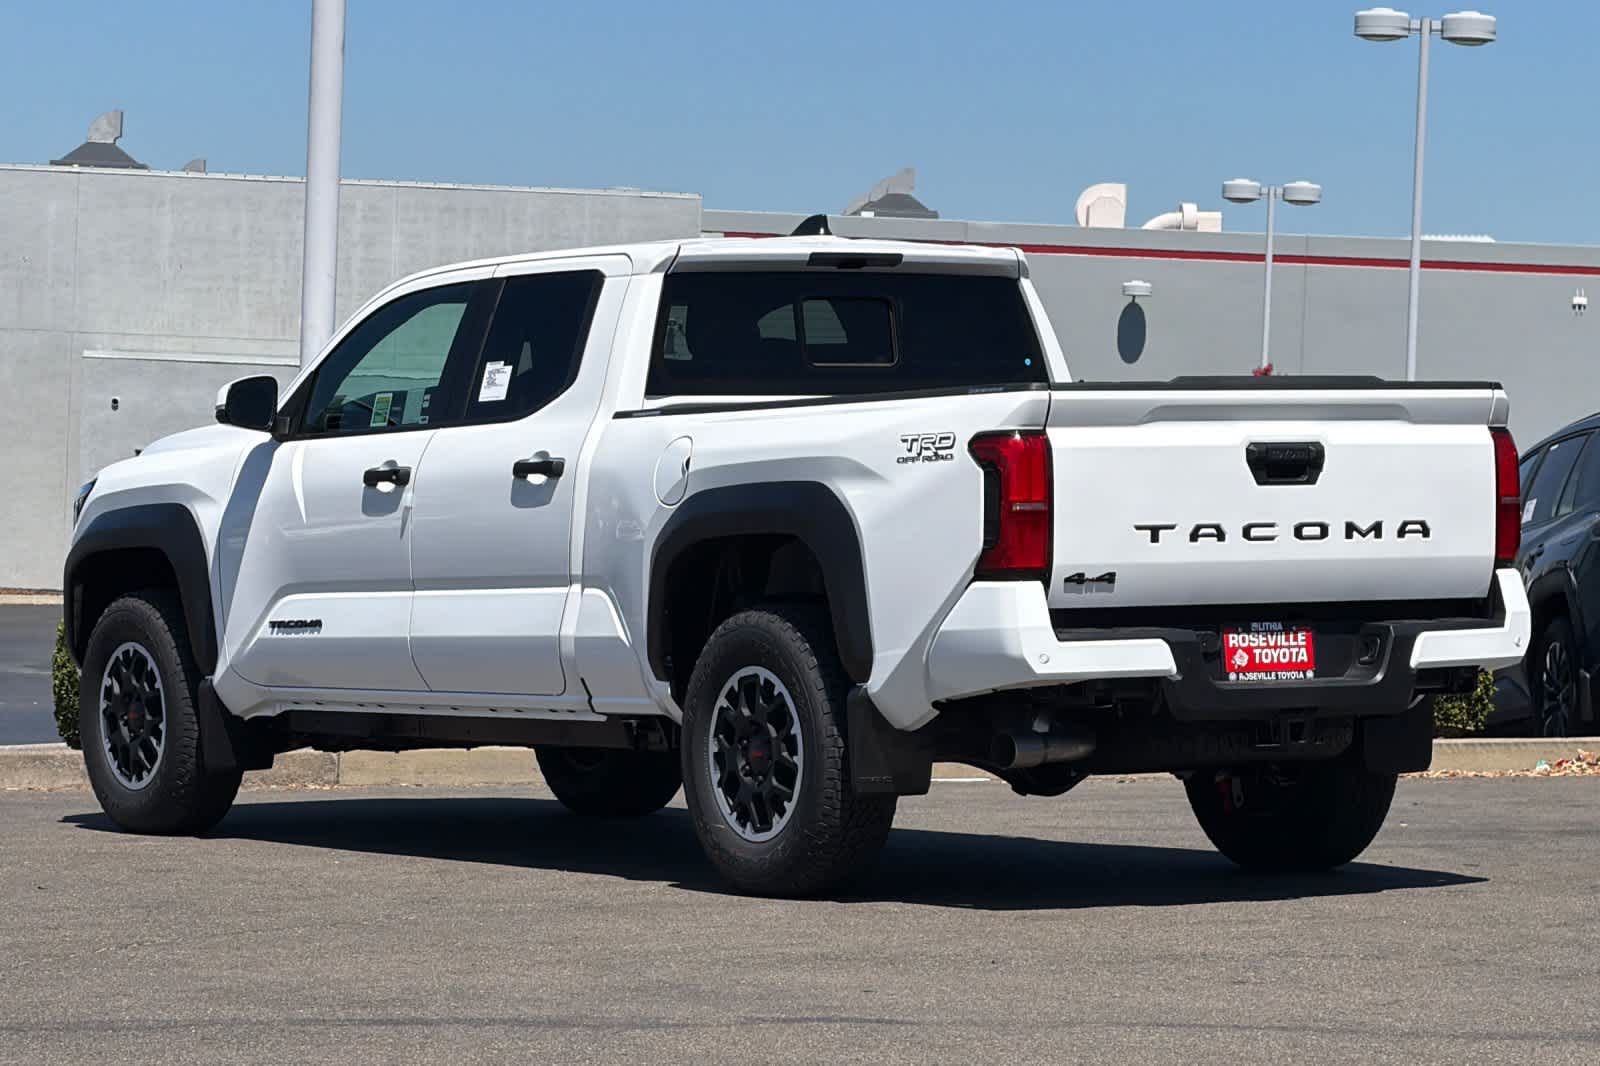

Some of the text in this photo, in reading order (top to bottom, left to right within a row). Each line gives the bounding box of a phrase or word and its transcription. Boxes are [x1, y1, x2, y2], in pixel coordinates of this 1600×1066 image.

[900, 431, 956, 456] TRD
[896, 453, 954, 464] OFF ROAD
[1133, 520, 1431, 544] TACOMA
[1258, 622, 1283, 631] LITHIA
[1228, 632, 1307, 647] ROSEVILLE
[1253, 648, 1308, 664] TOYOTA
